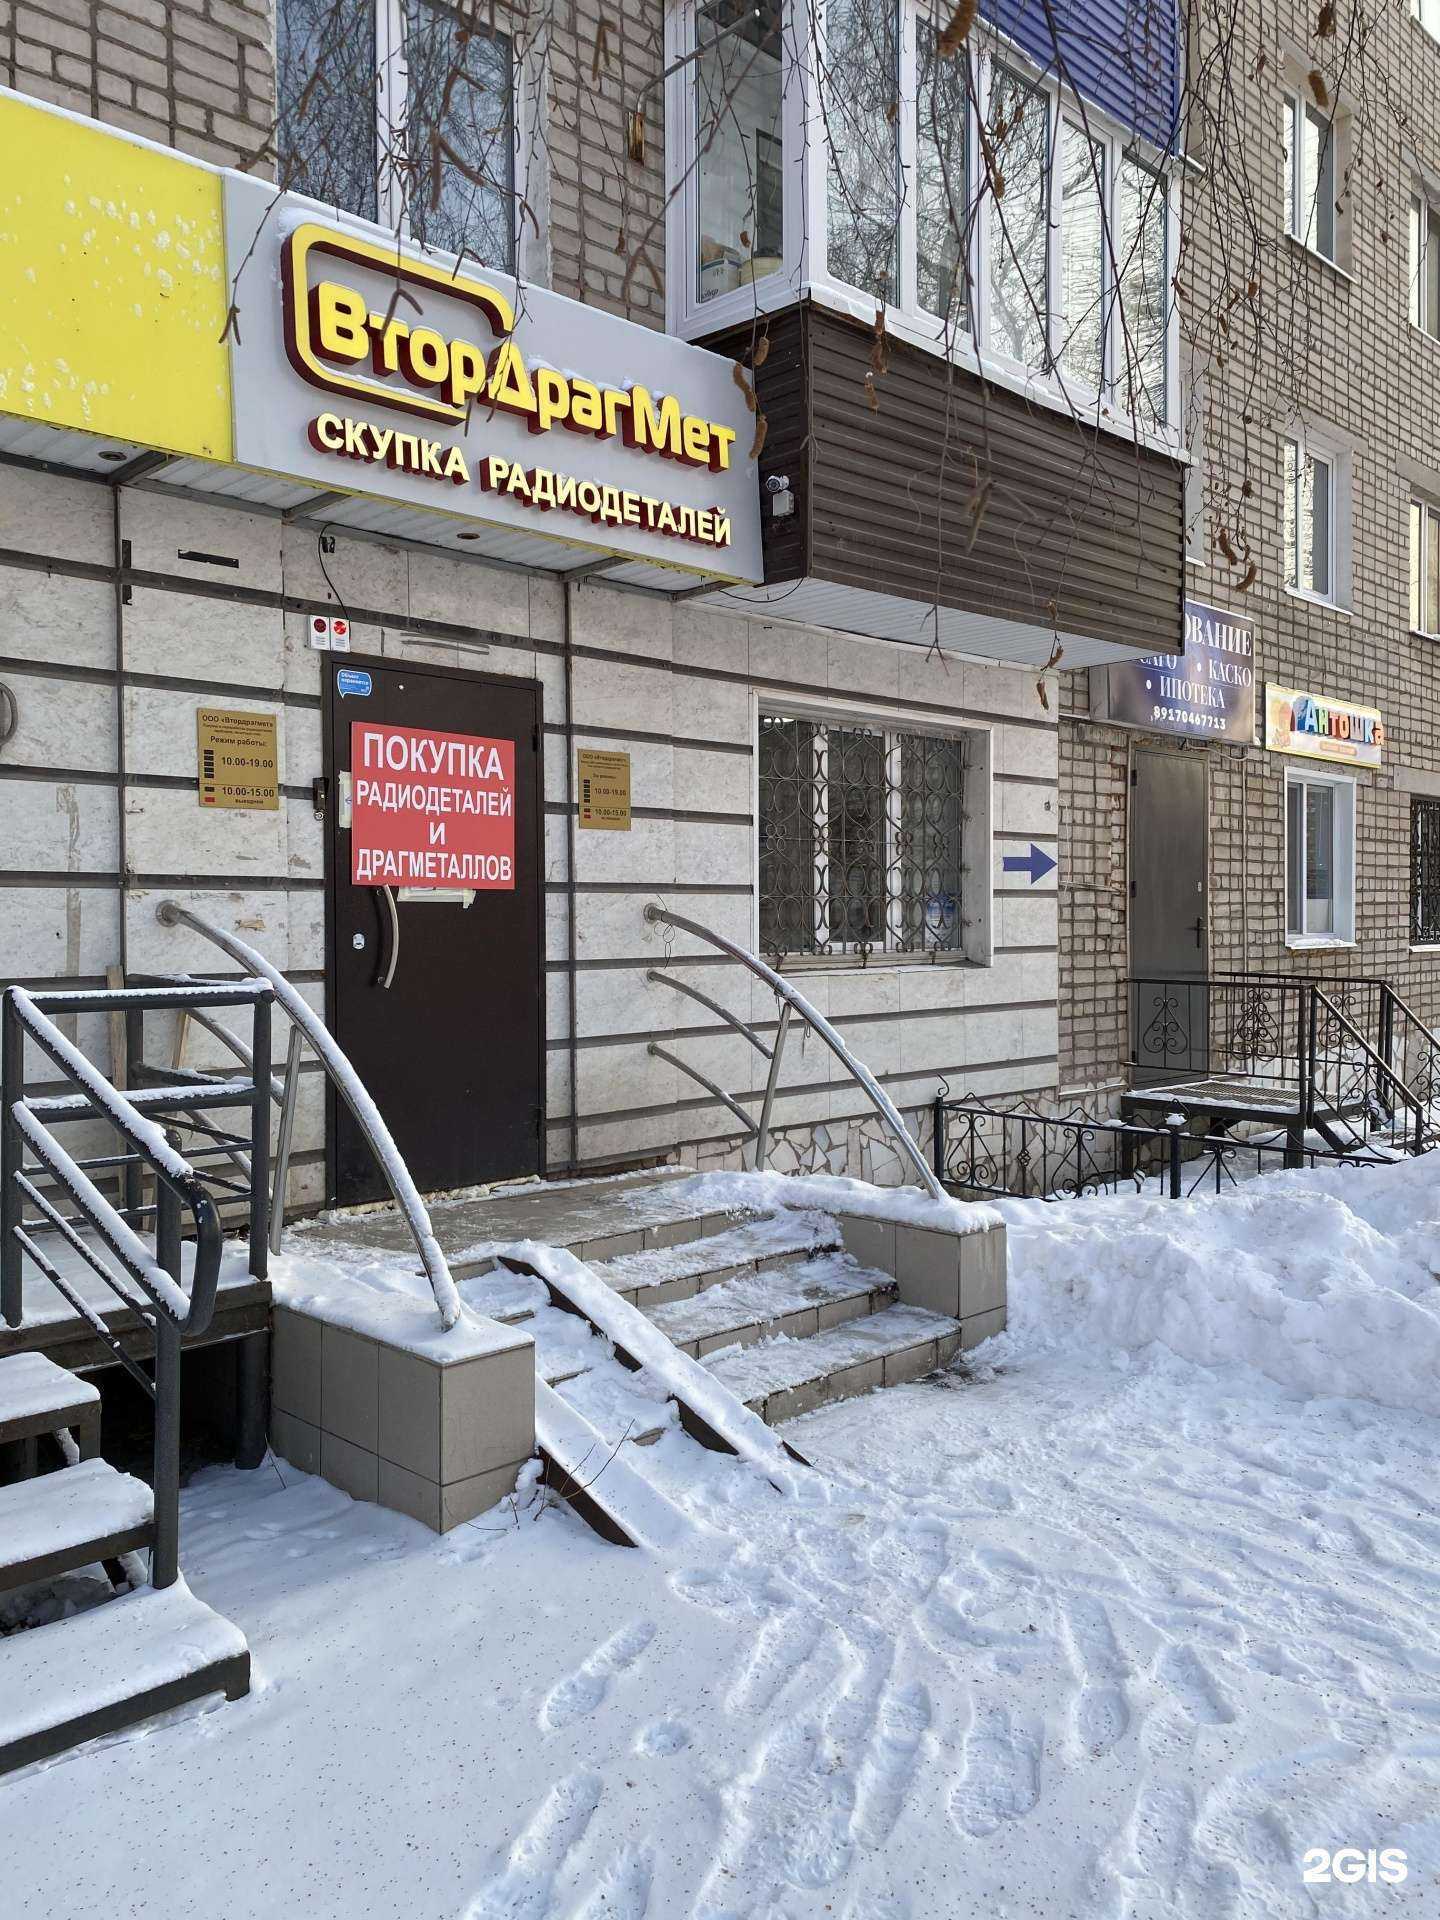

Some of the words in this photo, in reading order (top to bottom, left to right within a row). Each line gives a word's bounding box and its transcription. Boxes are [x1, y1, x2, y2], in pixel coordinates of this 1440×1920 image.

[317, 281, 735, 472] ВторДрагМет
[315, 411, 470, 482] СКУПКА
[488, 455, 732, 546] РАДИОДЕТАЛЕЙ
[1209, 659, 1252, 688] КАСКО
[1160, 675, 1226, 709] ИПОТЕКА
[202, 714, 219, 723] ООО
[363, 732, 505, 781] ПОКУПКА
[356, 779, 512, 817] РАДИОДЕТАЛЕЙ
[429, 822, 446, 845] И
[356, 848, 512, 881] ДРАГМЕТАЛЛОВ
